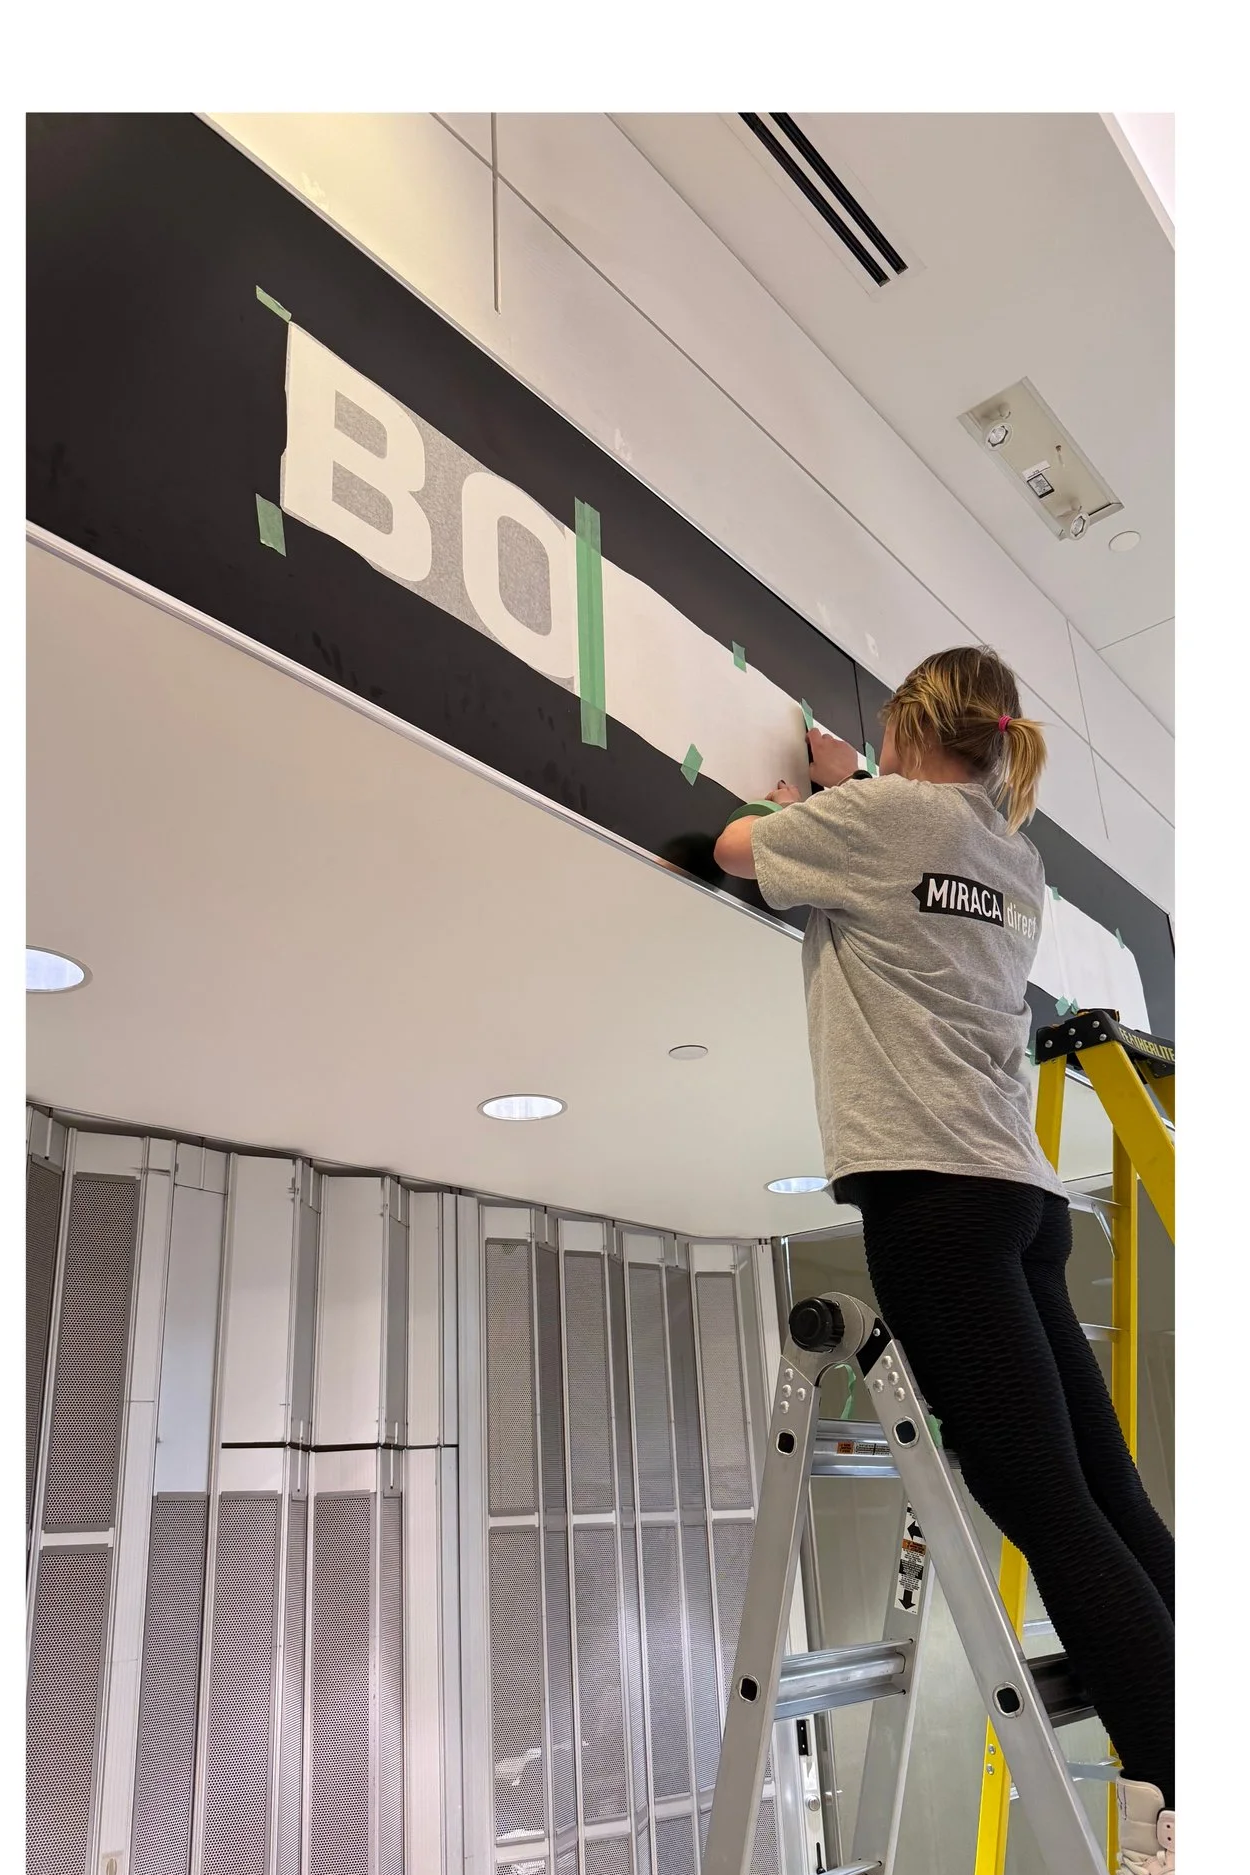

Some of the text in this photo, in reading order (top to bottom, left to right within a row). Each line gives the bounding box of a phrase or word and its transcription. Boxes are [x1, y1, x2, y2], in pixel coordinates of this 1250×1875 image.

[926, 878, 1037, 940] MIRACA direct
[1119, 1027, 1175, 1062] FEATHERLITE
